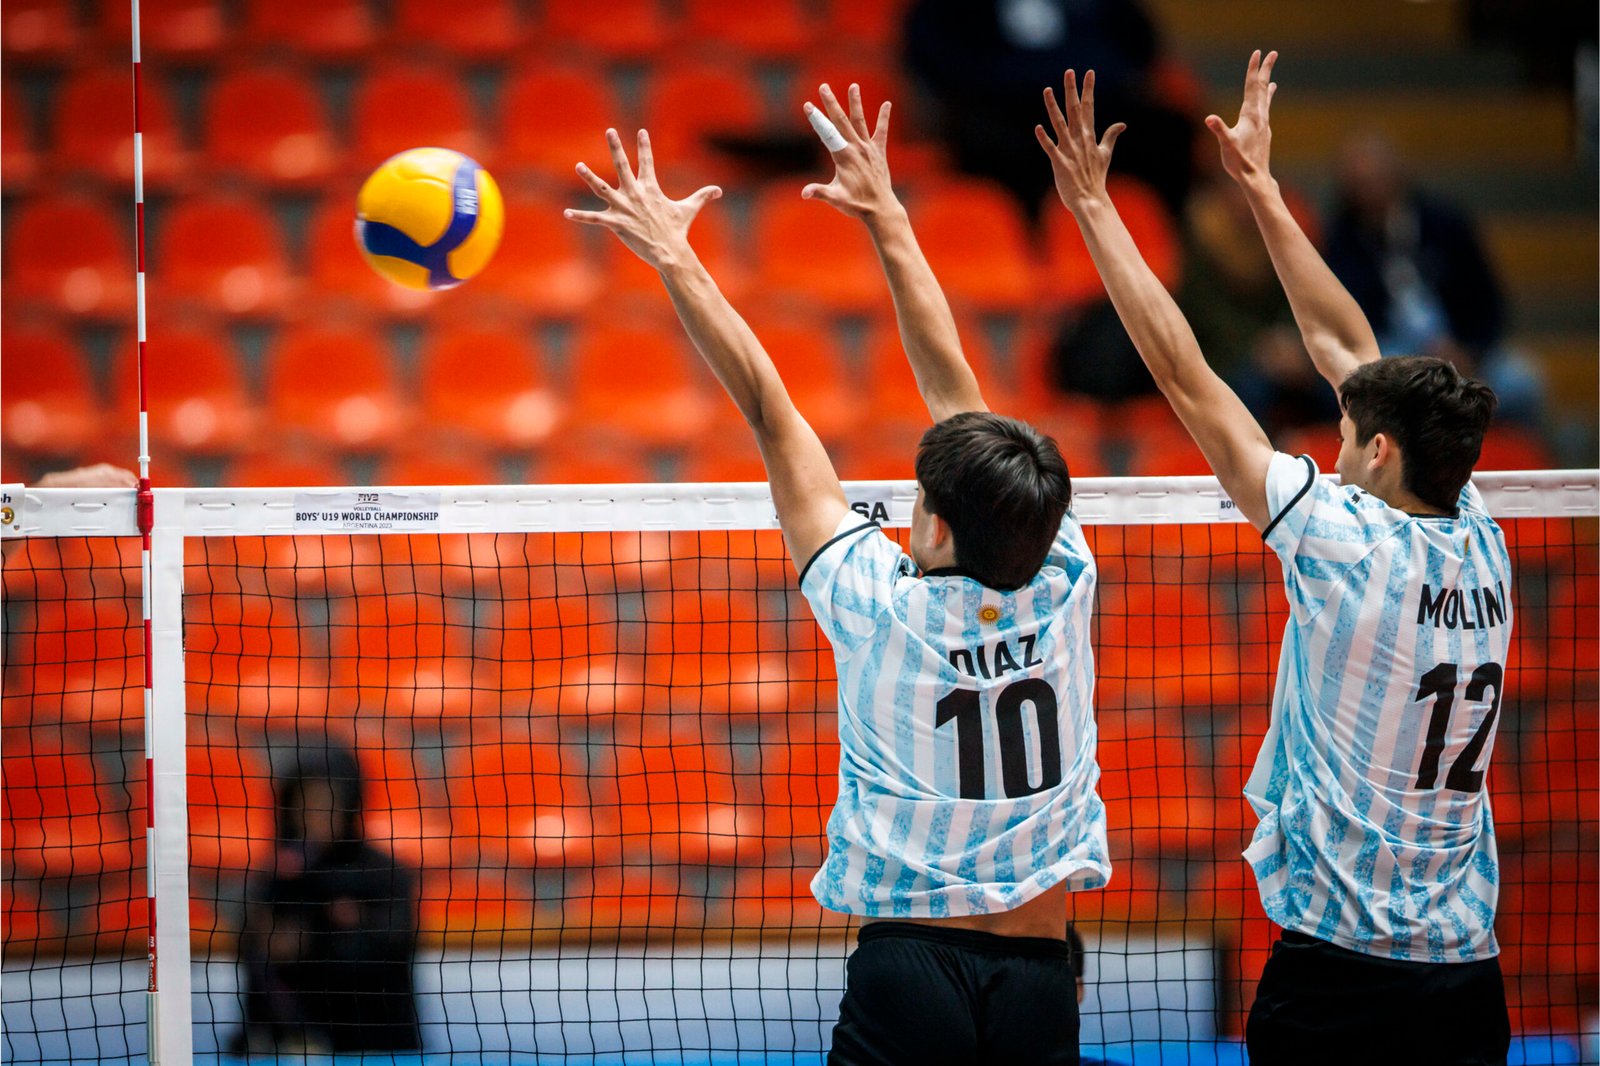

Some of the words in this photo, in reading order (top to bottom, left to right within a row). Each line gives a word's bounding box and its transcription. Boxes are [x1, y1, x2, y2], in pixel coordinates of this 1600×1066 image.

[322, 512, 339, 521] U19
[341, 512, 371, 521] WORLD
[374, 512, 439, 521] CHAMPIONSHIP
[358, 493, 379, 502] FIVB
[950, 633, 1043, 680] DIAZ
[935, 678, 1062, 801] 10
[1414, 662, 1503, 793] 12
